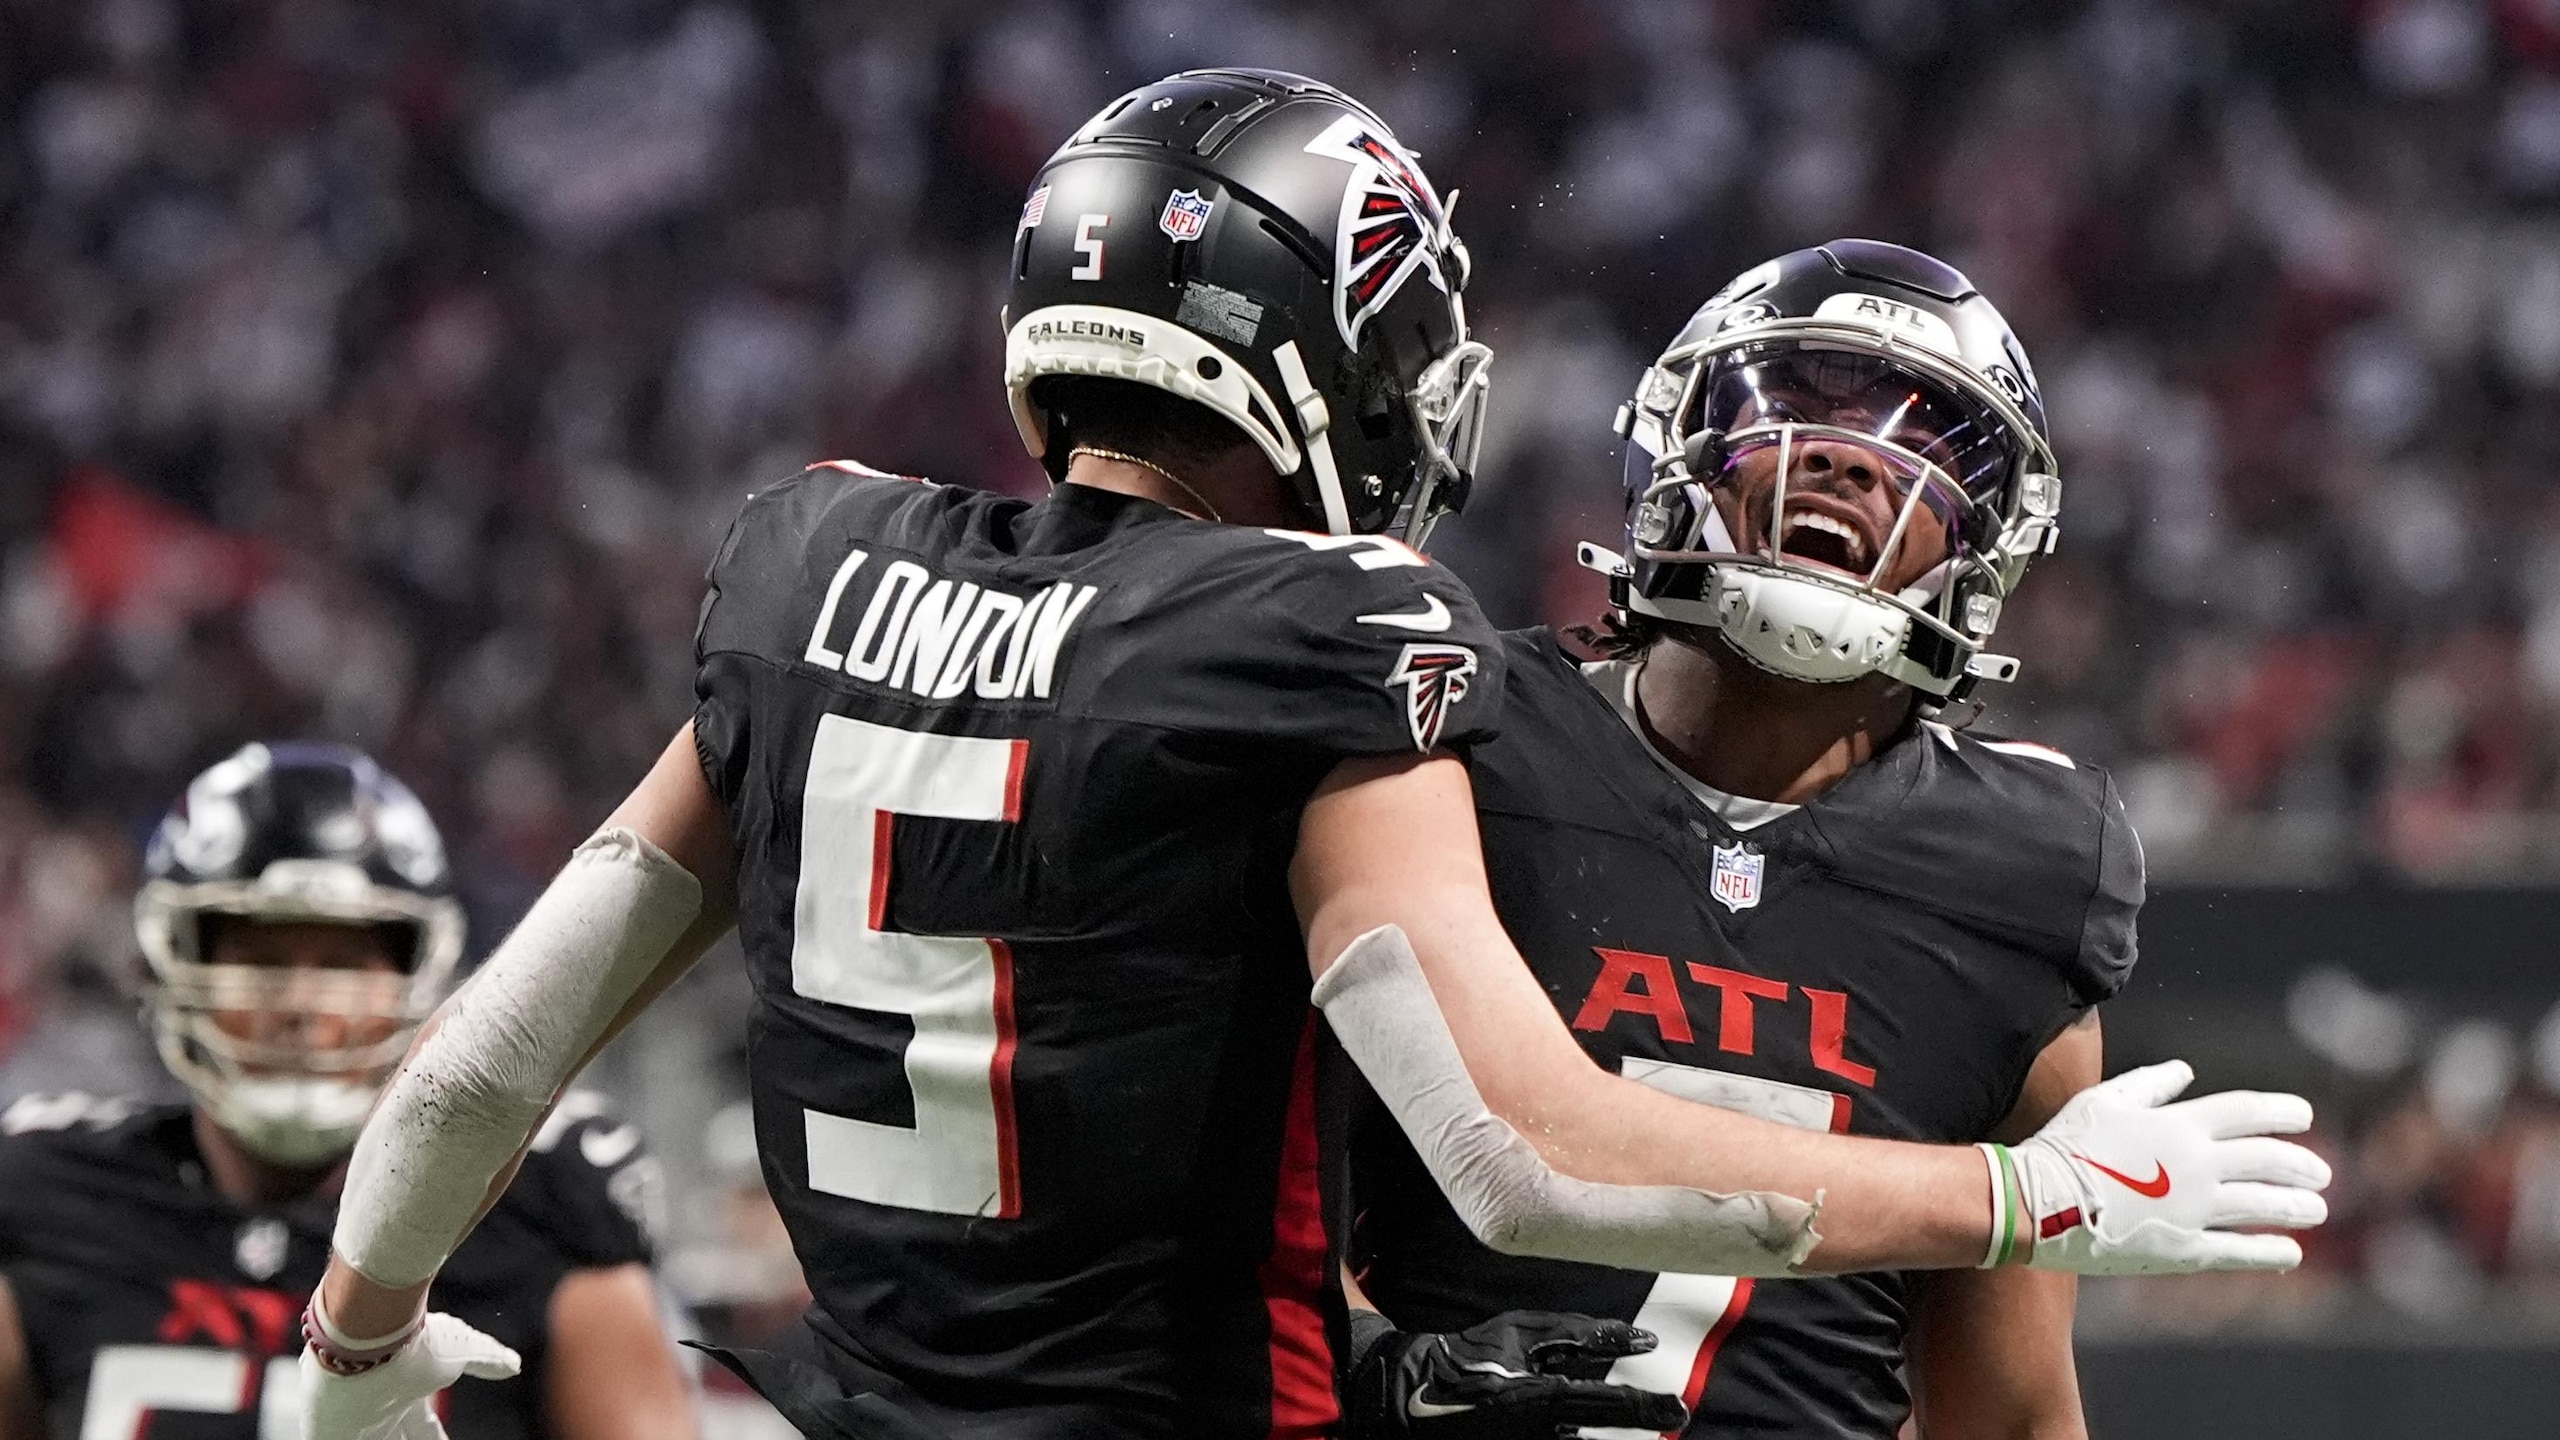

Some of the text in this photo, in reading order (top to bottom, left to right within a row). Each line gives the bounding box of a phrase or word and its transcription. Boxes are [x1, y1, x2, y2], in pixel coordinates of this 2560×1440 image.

[1166, 208, 1197, 234] NFL
[1072, 214, 1111, 281] 5
[1028, 320, 1145, 346] FALCONS
[1857, 296, 1926, 328] ATL
[805, 549, 1097, 700] LONDON
[1719, 871, 1752, 900] NFL
[793, 713, 1029, 1219] 5
[1572, 946, 1877, 1088] ATL
